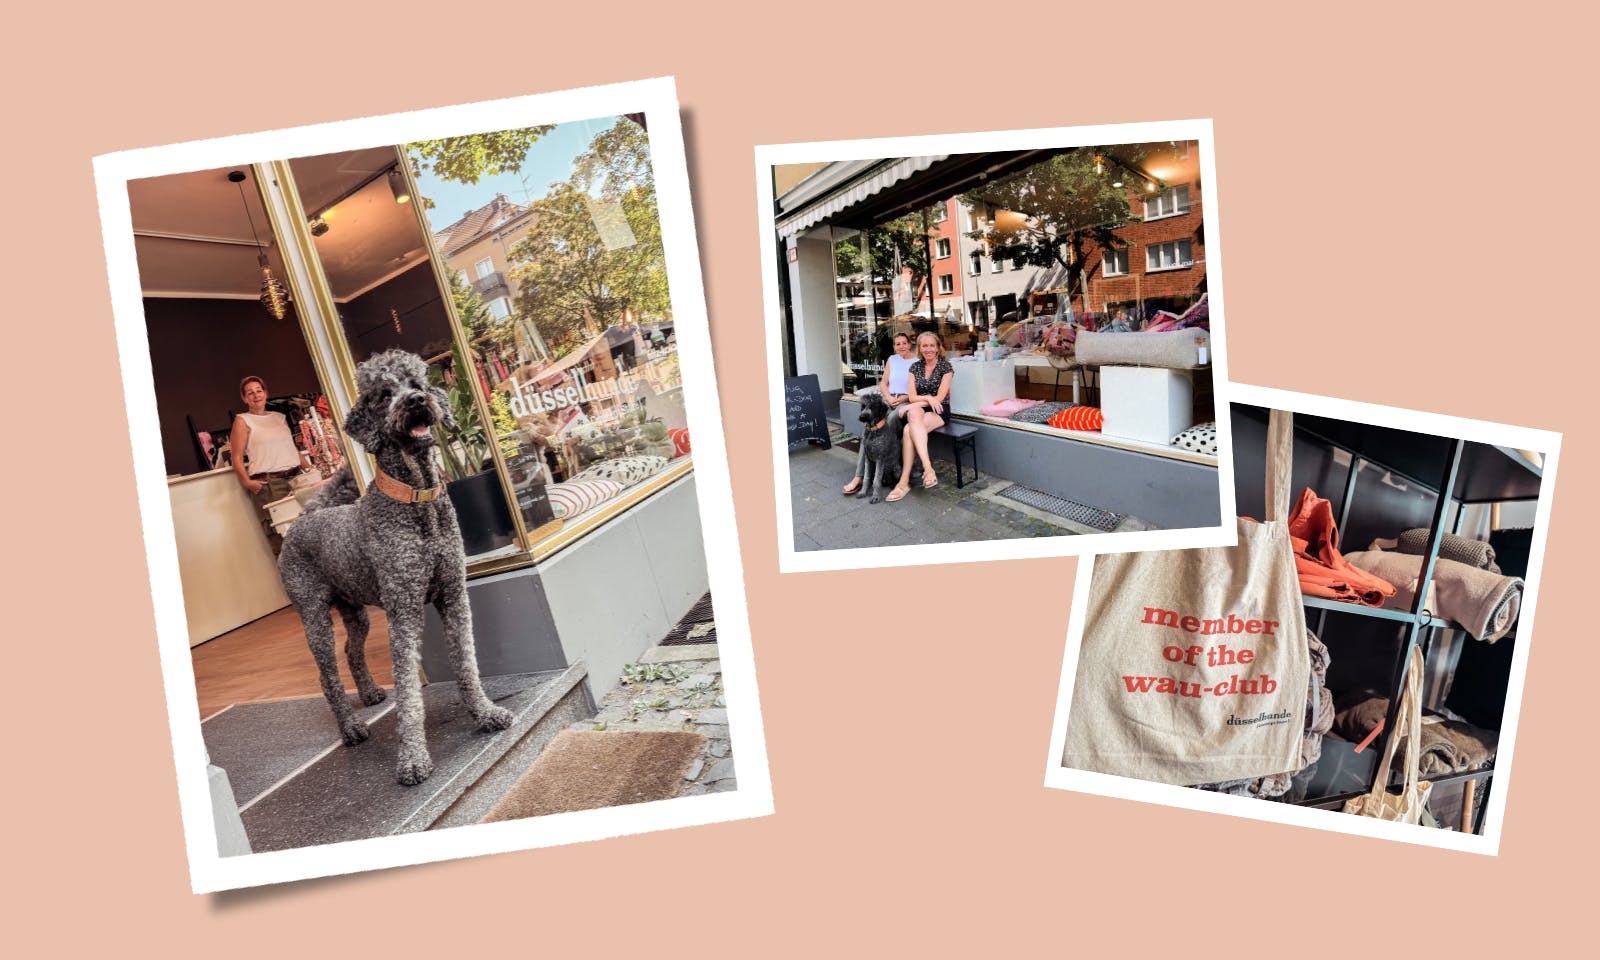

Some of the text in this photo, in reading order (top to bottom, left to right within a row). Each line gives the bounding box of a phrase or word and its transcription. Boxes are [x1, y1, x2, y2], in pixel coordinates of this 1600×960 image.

[1141, 606, 1279, 636] member
[1162, 644, 1254, 667] of the
[1122, 674, 1277, 699] wau-club
[1226, 709, 1292, 726] düsselhunde
